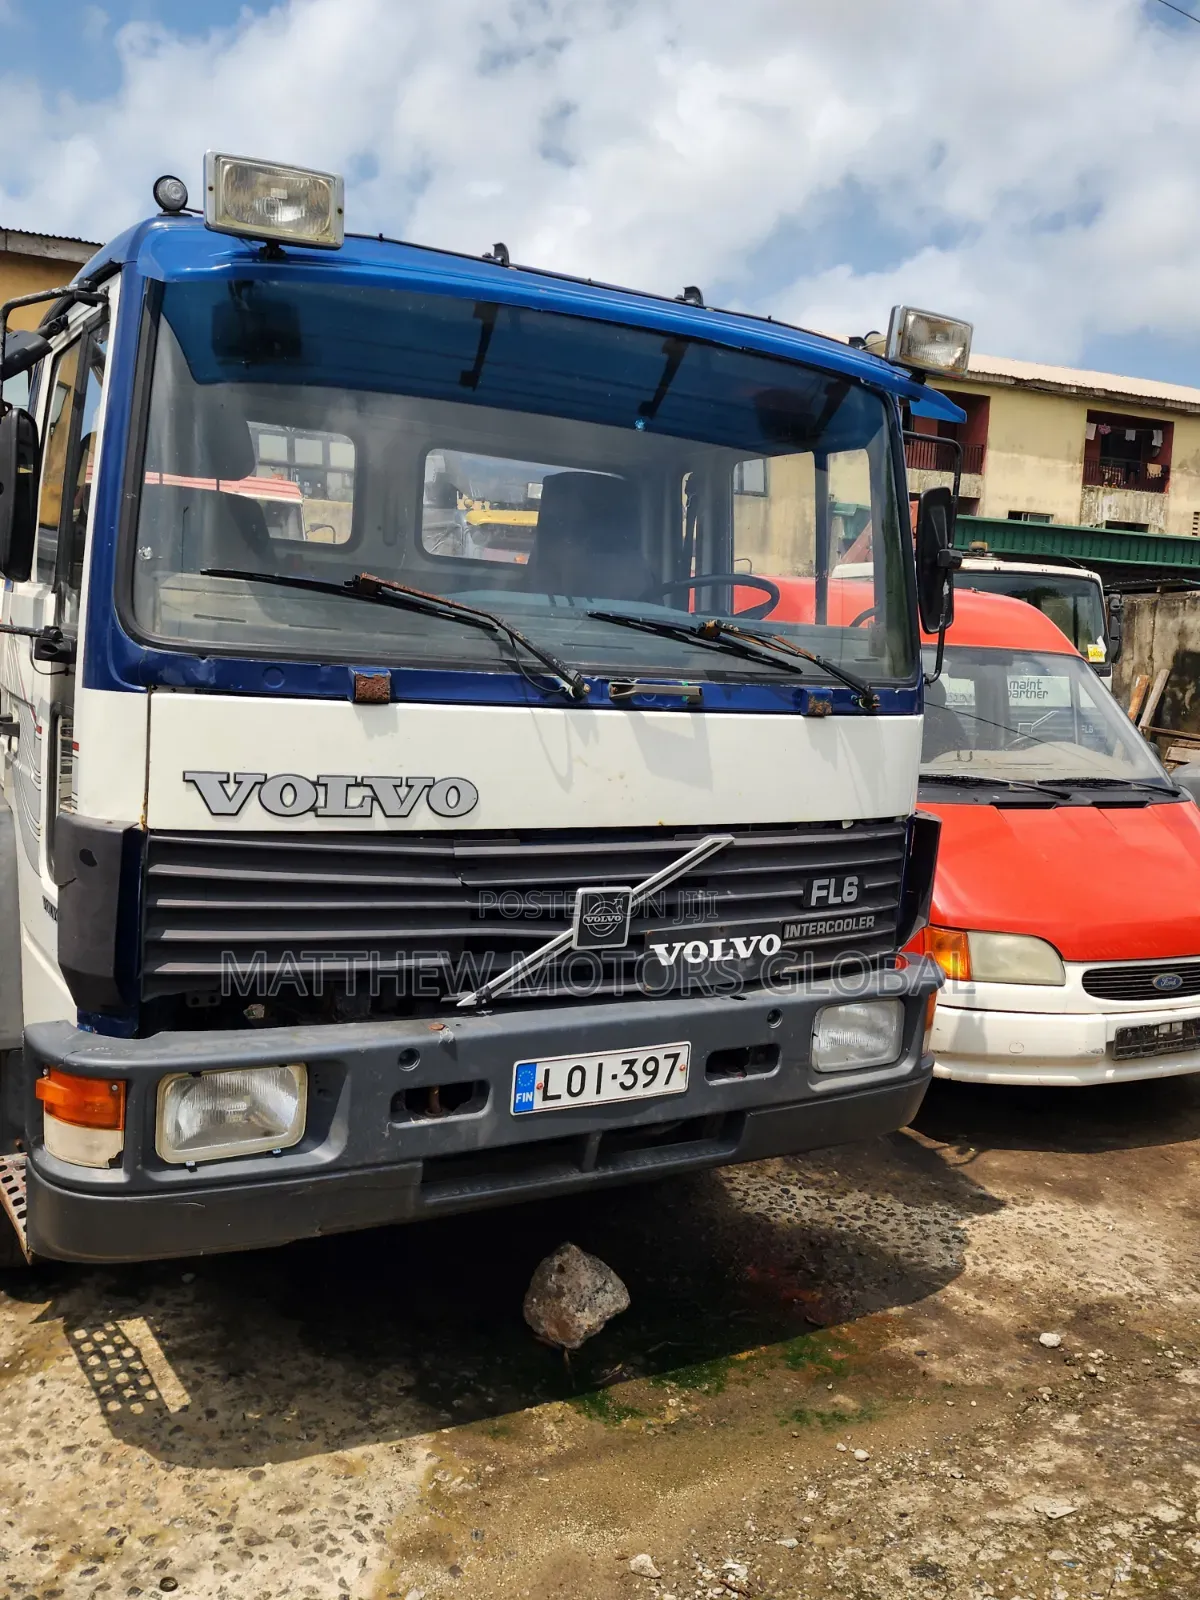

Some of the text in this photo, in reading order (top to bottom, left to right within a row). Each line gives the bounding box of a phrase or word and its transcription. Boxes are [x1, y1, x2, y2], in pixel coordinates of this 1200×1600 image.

[1009, 677, 1043, 690] maint
[183, 770, 479, 818] VOLVO
[810, 875, 859, 906] FL6
[585, 914, 623, 924] VOLVO
[783, 914, 876, 940] INTERCOOLER
[649, 932, 782, 967] VOLVO
[515, 1091, 533, 1104] FIN
